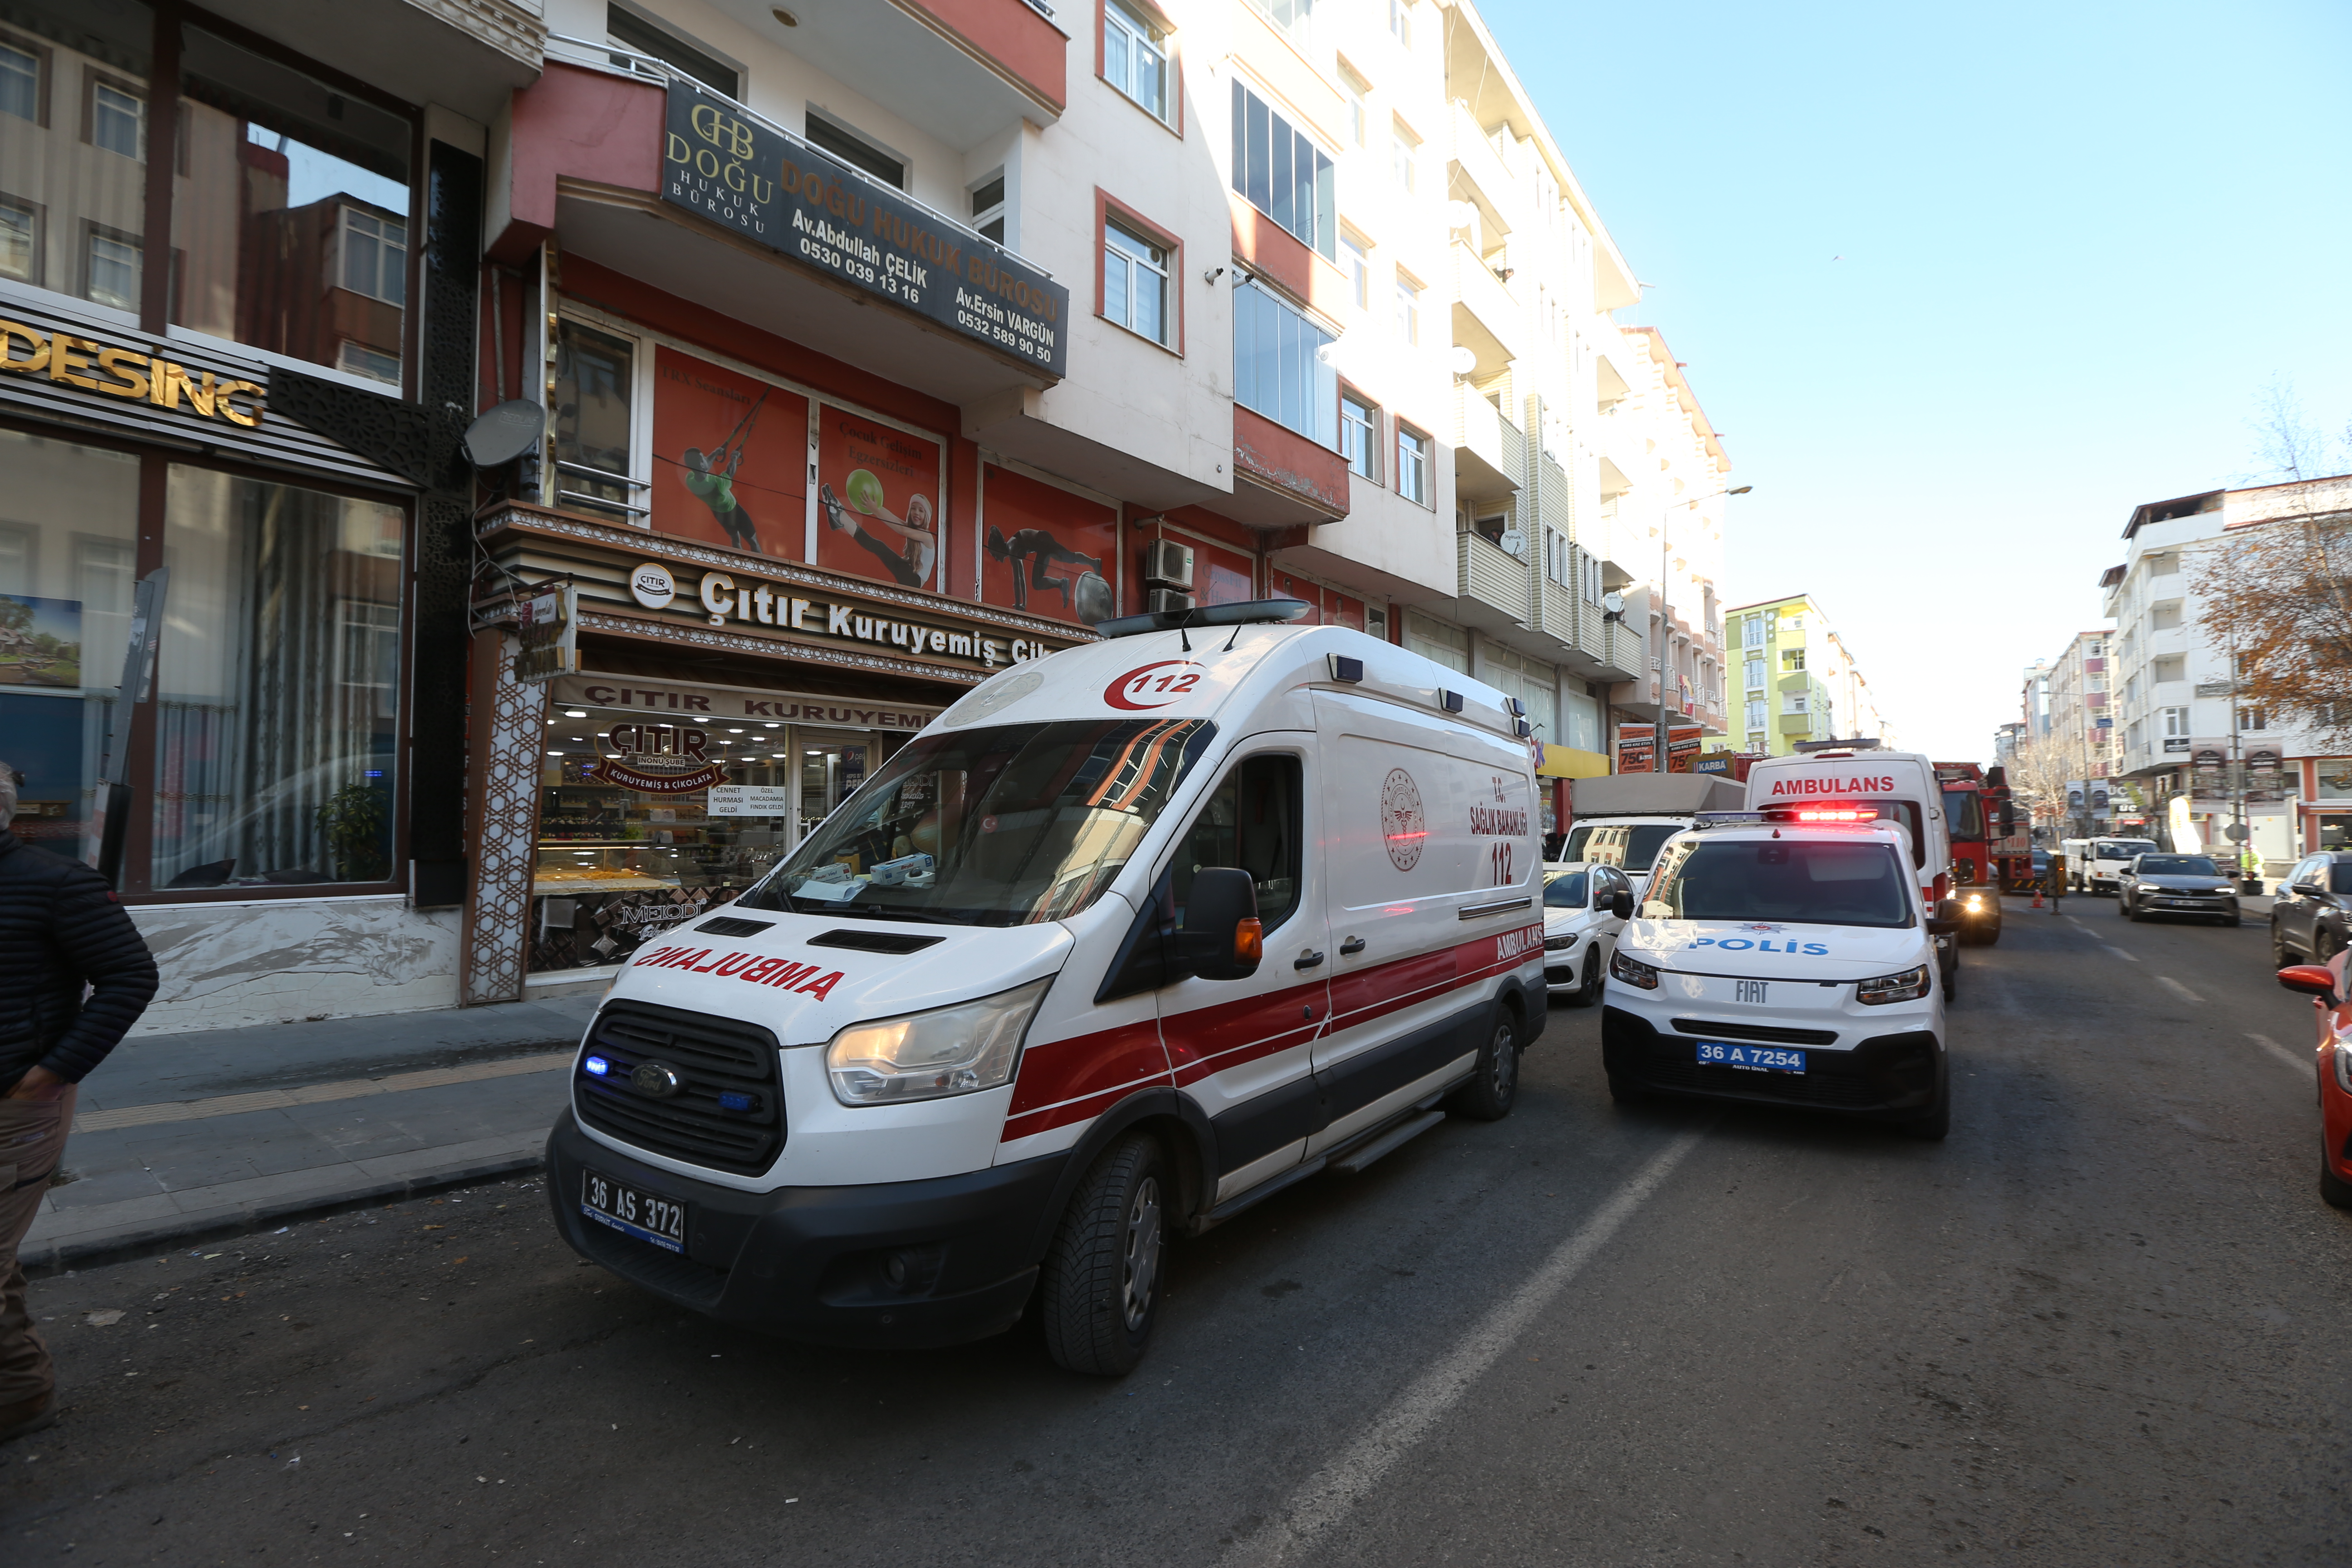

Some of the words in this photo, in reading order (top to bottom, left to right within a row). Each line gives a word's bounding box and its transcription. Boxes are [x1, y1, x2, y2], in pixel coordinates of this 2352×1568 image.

[666, 132, 773, 204] DOĞU
[672, 182, 764, 233] BÜROSU
[681, 170, 758, 216] HUKUK
[781, 159, 865, 226] DOĞU
[874, 206, 961, 276] HUKUK
[969, 255, 1057, 322] BÜROSU
[792, 208, 880, 267] Av.Abdullah
[886, 252, 927, 289] ÇELİK
[800, 238, 841, 269] 0530
[846, 259, 874, 283] 039
[880, 274, 897, 294] 13
[902, 285, 919, 304] 16
[956, 286, 1004, 324] Av.Ersin
[1007, 309, 1054, 348] VARGÜN
[958, 310, 990, 335] 0532
[993, 326, 1015, 347] 589
[1019, 338, 1034, 355] 90
[1037, 346, 1051, 363] 50
[661, 365, 691, 386] TRX
[840, 422, 877, 445] Çocuk
[880, 436, 922, 460] Gelişim
[849, 446, 913, 476] Egzersizleri
[640, 575, 665, 588] ÇITIR
[1203, 564, 1242, 588] CrossFit
[700, 572, 811, 627] Çıtır
[829, 603, 996, 667] Kuruyemiş
[1132, 674, 1200, 693] 112
[584, 686, 711, 711] ÇITIR
[745, 700, 931, 728] KURUYEMİ
[608, 723, 707, 764] ÇITIR
[1531, 740, 1546, 769] OK
[638, 756, 664, 765] İNÖNÜ
[665, 758, 685, 767] ŞUBE
[1621, 752, 1645, 765] 750
[1671, 755, 1688, 769] 75
[1699, 761, 1726, 771] KARBA
[610, 769, 662, 790] KURUYEMİŞ
[672, 773, 712, 790] ÇİKOLATA
[1492, 776, 1505, 803] T.C.
[1772, 776, 1894, 795] AMBULANS
[1470, 801, 1496, 835] SAĞLIK
[1498, 807, 1528, 836] BAKANLIĞI
[2011, 838, 2026, 847] 110
[1492, 843, 1512, 886] 112
[1497, 924, 1543, 960] AMBULANS
[1688, 938, 1829, 956] POLİS
[1736, 980, 1769, 1004] FIAT
[1701, 1045, 1725, 1059] 36
[1730, 1048, 1745, 1062] A
[1751, 1049, 1801, 1067] 7254
[637, 1069, 661, 1091] Ford
[591, 1177, 607, 1209] 36
[617, 1188, 636, 1220] AS
[646, 1199, 680, 1236] 372
